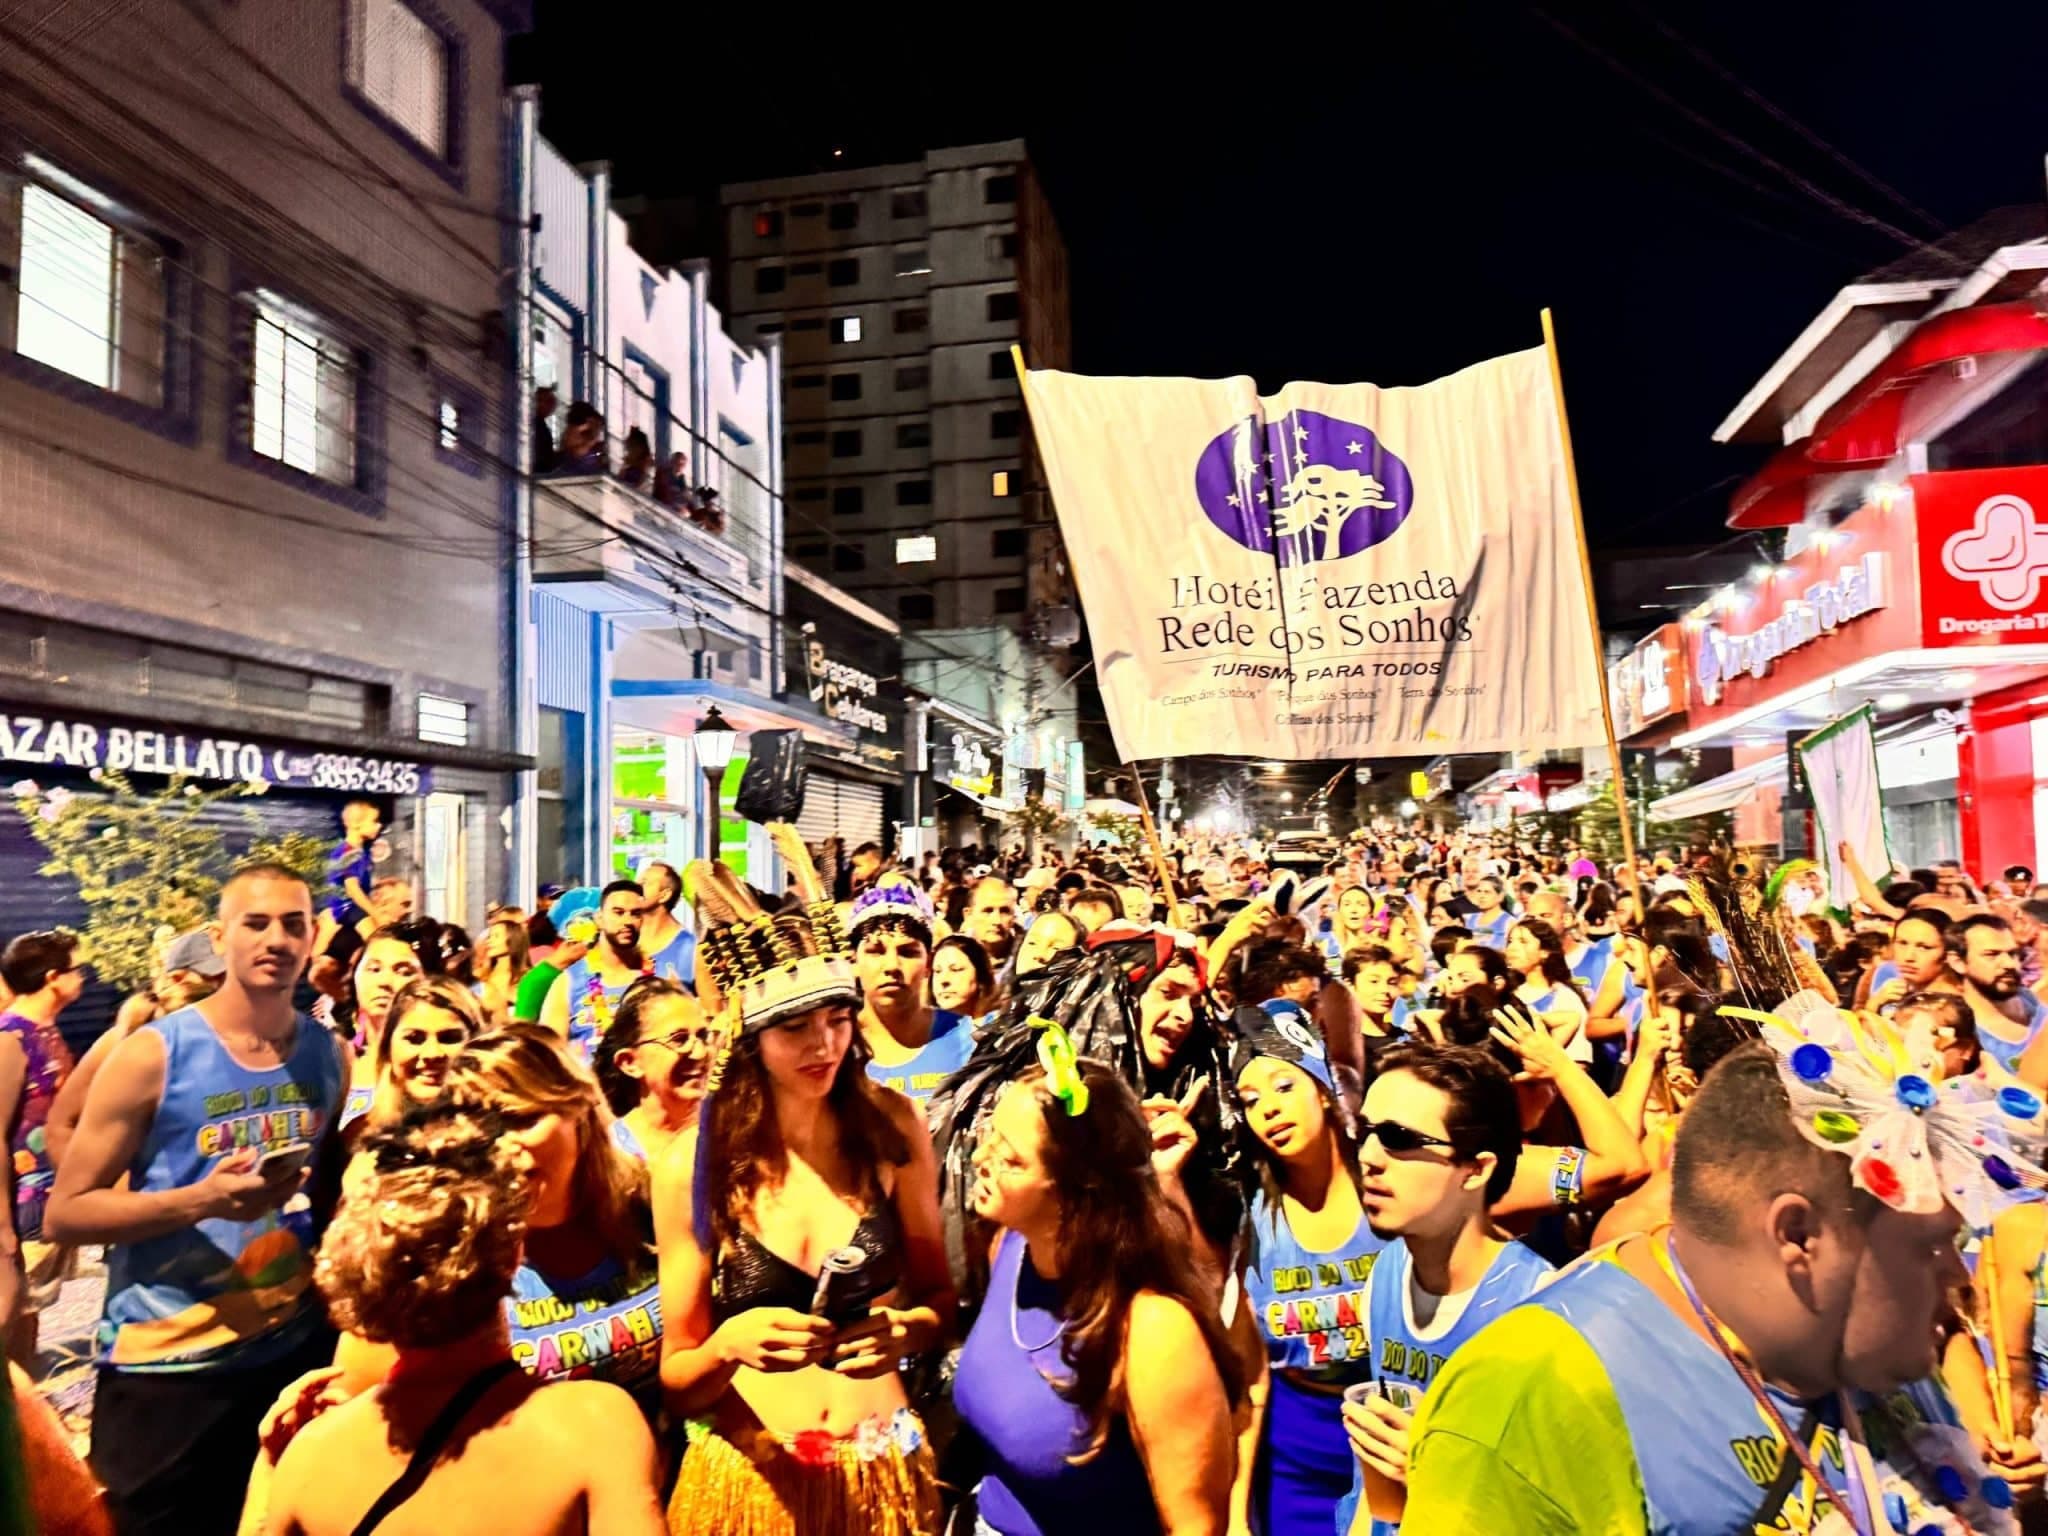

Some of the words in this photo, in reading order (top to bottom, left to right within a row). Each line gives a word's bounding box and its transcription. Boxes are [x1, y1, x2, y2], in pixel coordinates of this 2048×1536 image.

[1169, 575, 1279, 611] Hotéi
[1157, 610, 1257, 653] Rede
[1338, 606, 1473, 647] Sonhos
[1212, 662, 1298, 684] TURISMO
[1305, 664, 1366, 682] PARA
[1371, 662, 1442, 677] TODOS
[106, 728, 264, 781] BELLATO
